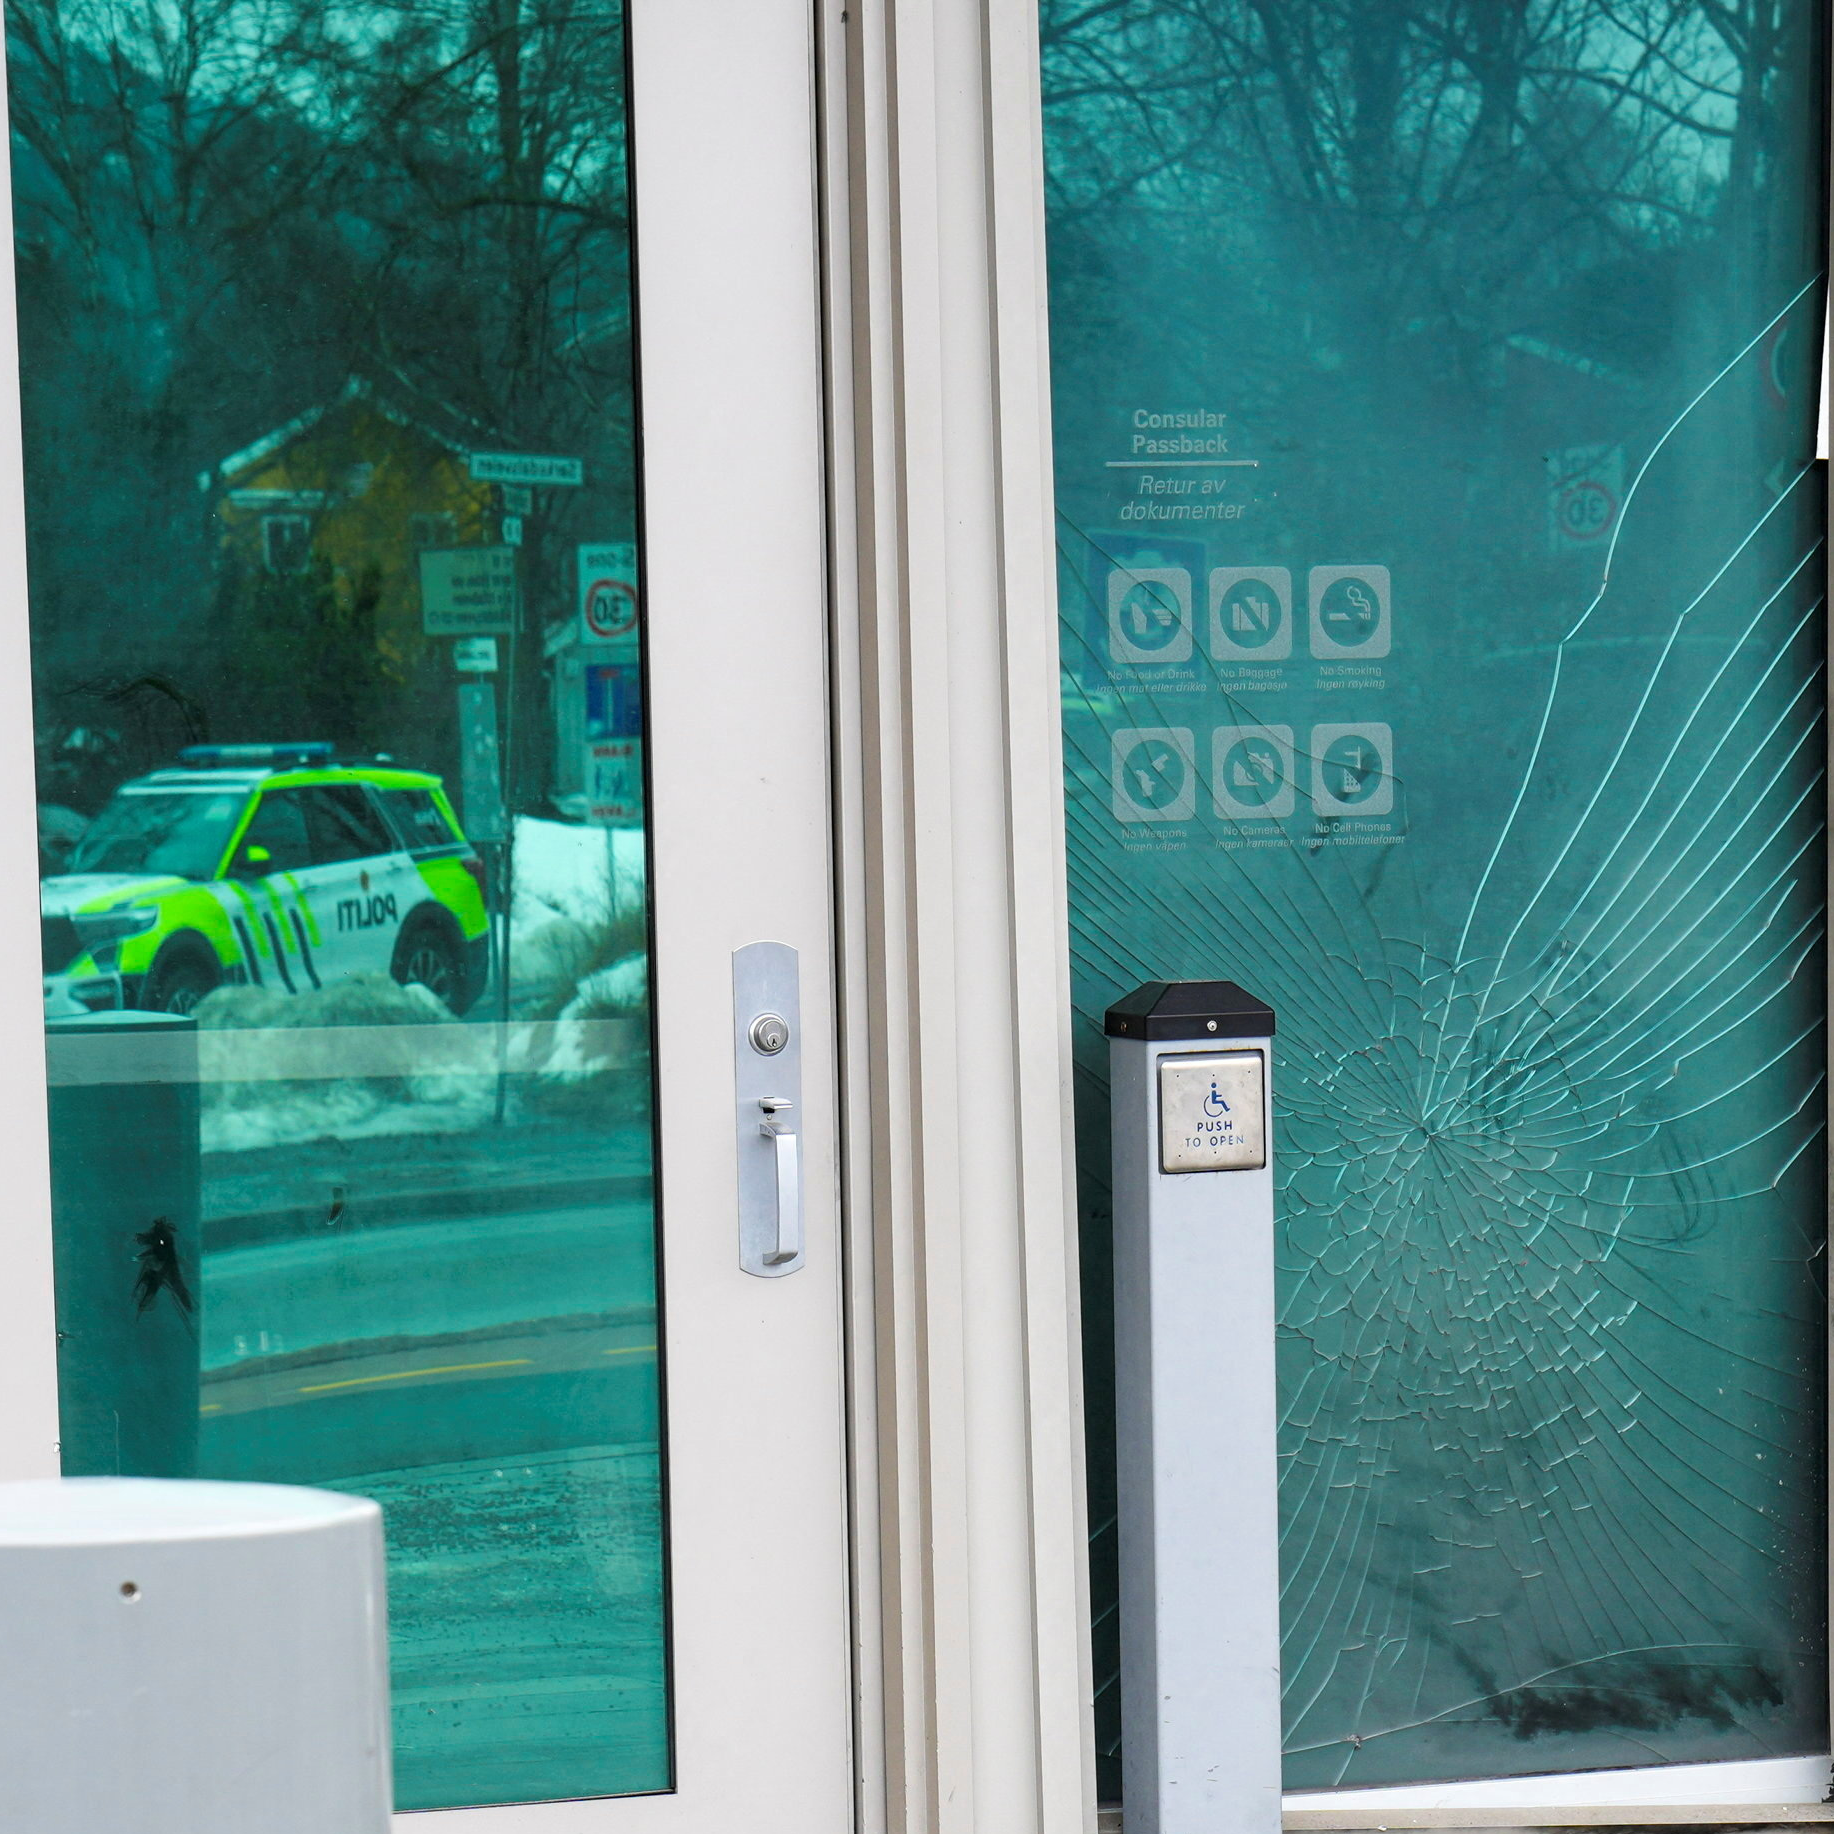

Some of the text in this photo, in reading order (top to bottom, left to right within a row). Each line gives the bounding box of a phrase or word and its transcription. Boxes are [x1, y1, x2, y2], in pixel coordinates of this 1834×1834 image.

[1133, 408, 1227, 429] Consular
[1132, 434, 1229, 454] Passback
[1138, 475, 1226, 495] Retur av
[1120, 500, 1246, 521] dokumenter
[1107, 669, 1123, 680] No
[1126, 669, 1152, 680] Food
[1168, 668, 1196, 680] Drink
[1220, 667, 1283, 680] No Baggage
[1319, 665, 1382, 678] No Smoking
[1151, 683, 1173, 693] eller
[1176, 682, 1207, 692] drikke
[1218, 681, 1246, 693] Ingen
[1317, 678, 1386, 690] Ingen røyking
[1121, 828, 1187, 840] No Weapons
[1223, 824, 1286, 836] No Cameras
[1315, 822, 1391, 834] No Cell Phones
[1124, 840, 1187, 853] Ingen våpen
[1216, 837, 1294, 850] Ingen kameraer
[1301, 835, 1405, 848] Ingen mobiltelefoner
[1197, 1120, 1233, 1132] PUSH
[1185, 1135, 1244, 1148] TO OPEN
